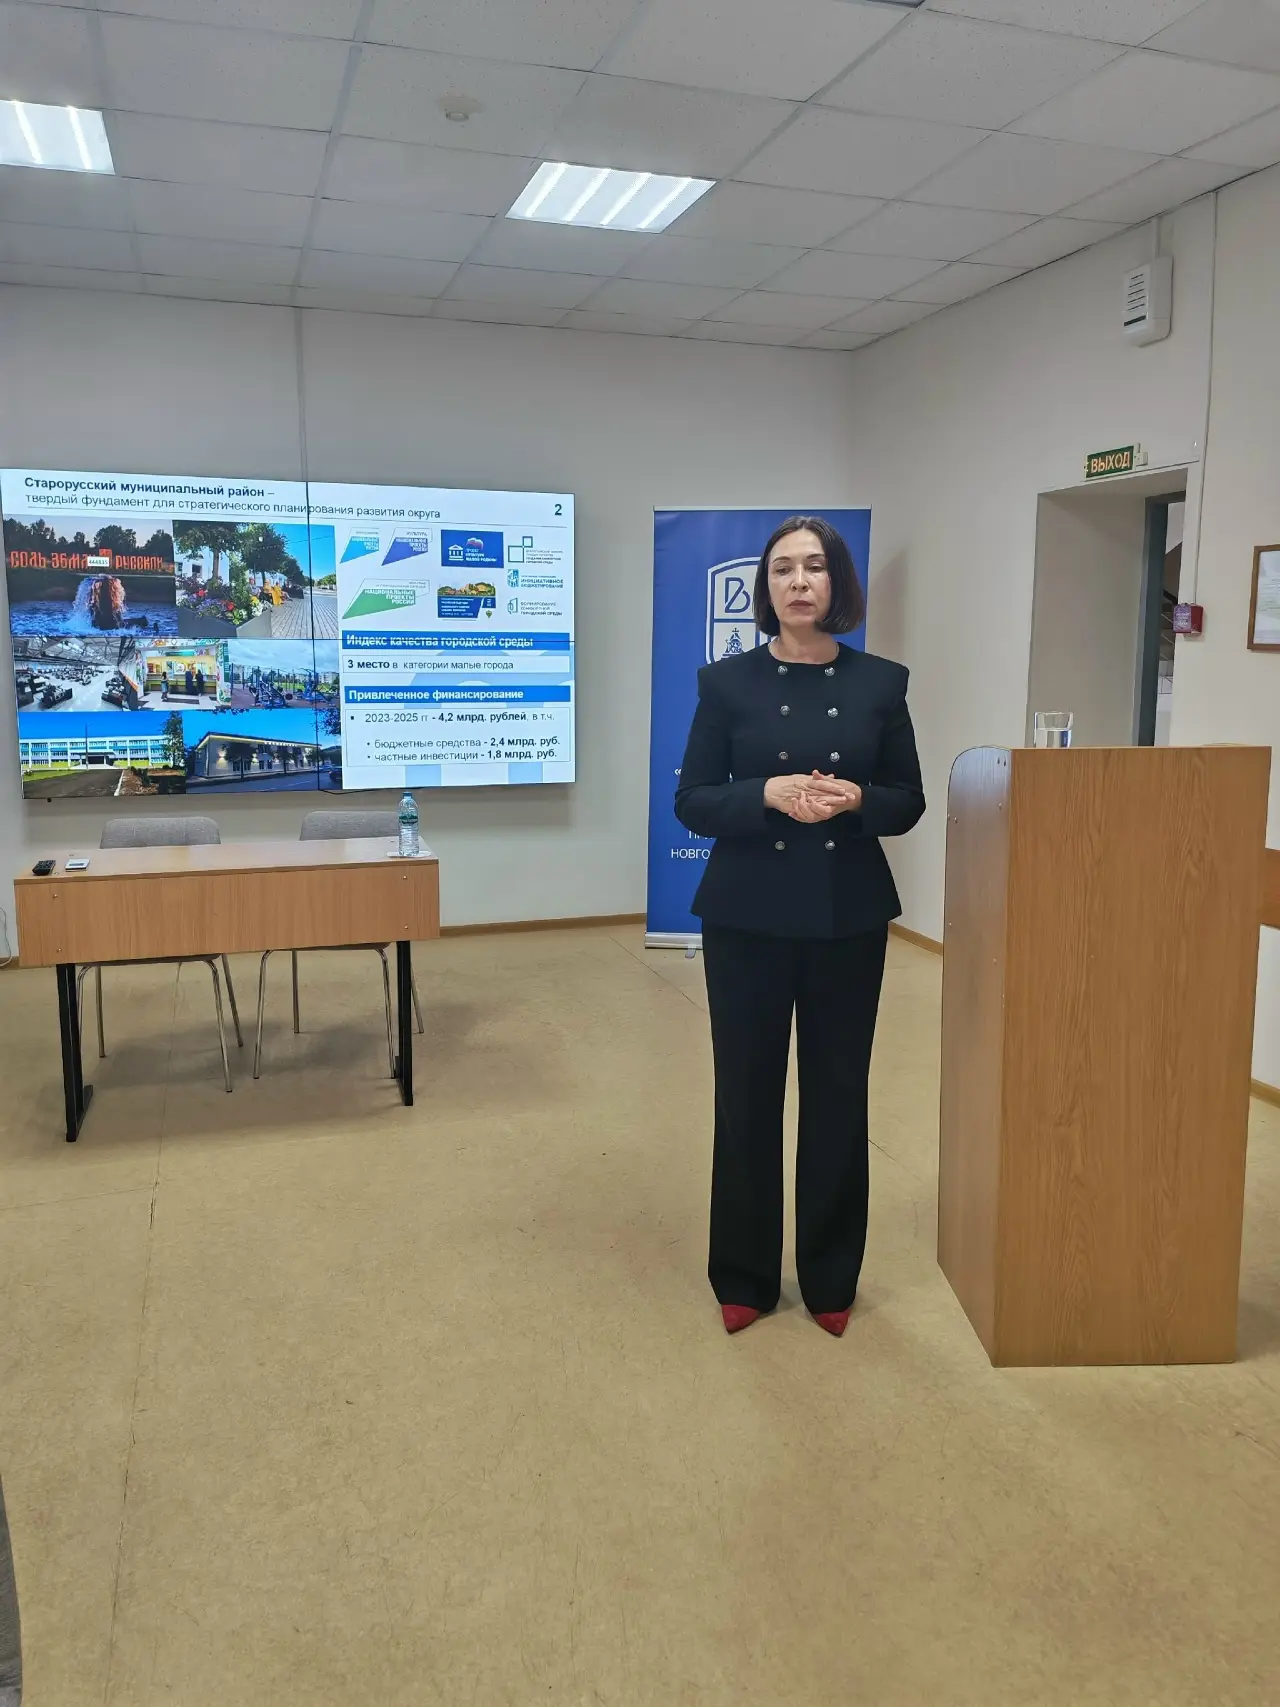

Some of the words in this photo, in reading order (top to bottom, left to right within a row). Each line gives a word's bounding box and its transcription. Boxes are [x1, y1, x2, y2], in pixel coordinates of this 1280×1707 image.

[1091, 451, 1130, 473] ВЫХОД
[24, 477, 117, 491] Старорусский
[121, 482, 224, 496] муниципальный
[228, 486, 265, 498] район
[25, 494, 78, 506] твердый
[81, 494, 150, 507] фундамент
[153, 499, 175, 509] для
[179, 500, 270, 511] стратегического
[273, 504, 354, 515] планирования
[356, 508, 405, 516] развития
[407, 509, 441, 519] округа
[554, 504, 563, 516] 2
[346, 635, 388, 646] Индекс
[390, 637, 439, 646] качества
[441, 636, 497, 648] городской
[499, 638, 533, 648] среды
[347, 660, 354, 669] 3
[357, 661, 390, 669] место
[403, 662, 449, 671] категории
[483, 663, 514, 671] города
[349, 690, 430, 701] Привлеченное
[432, 690, 524, 701] финансирование
[365, 713, 419, 722] 2023-2025
[438, 713, 454, 723] 4,2
[456, 714, 487, 723] млрд.
[374, 739, 434, 749] бюджетные
[436, 740, 482, 749] средства
[490, 738, 505, 748] 2,4
[507, 738, 538, 748] млрд.
[540, 737, 560, 747] руб.
[375, 753, 418, 762] частные
[420, 751, 478, 761] инвестиции
[487, 750, 502, 760] 1,8
[504, 750, 534, 760] млрд.
[536, 749, 557, 759] руб.
[671, 848, 711, 860] НОВГО
